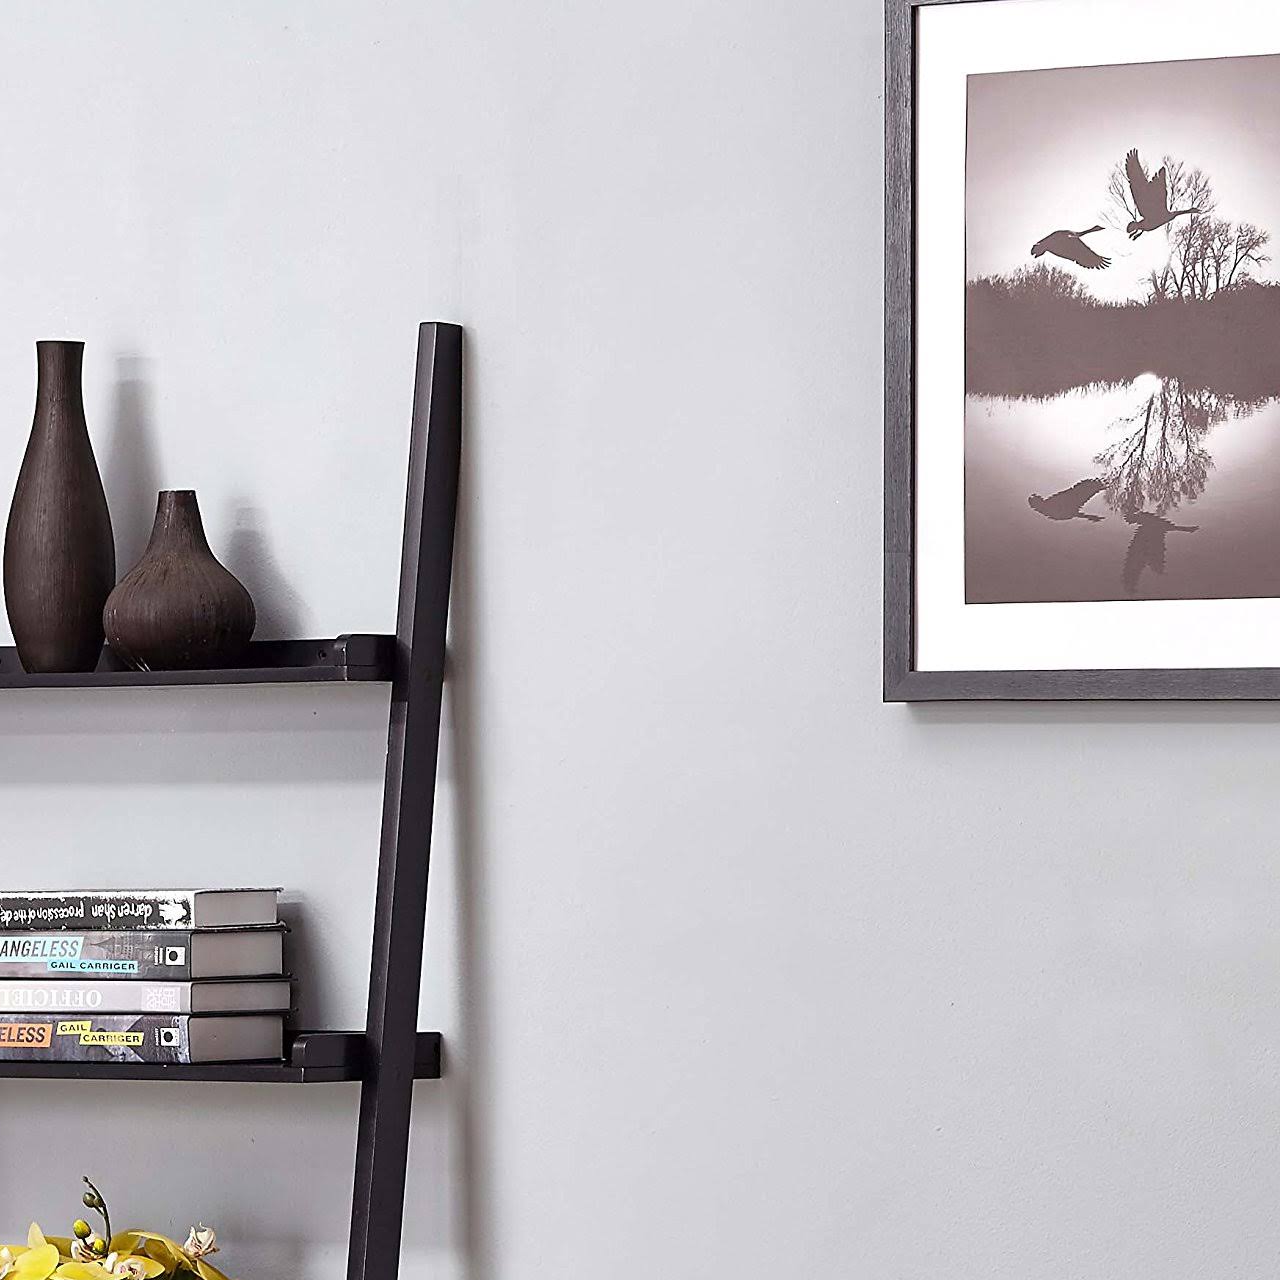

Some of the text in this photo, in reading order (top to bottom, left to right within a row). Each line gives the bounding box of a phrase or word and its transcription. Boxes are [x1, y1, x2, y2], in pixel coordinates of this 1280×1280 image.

[37, 901, 85, 922] procession
[117, 901, 153, 921] darren
[50, 961, 136, 971] GAIL CARRIGER
[59, 1023, 88, 1034] GAIL
[82, 1033, 141, 1044] CARRIGER
